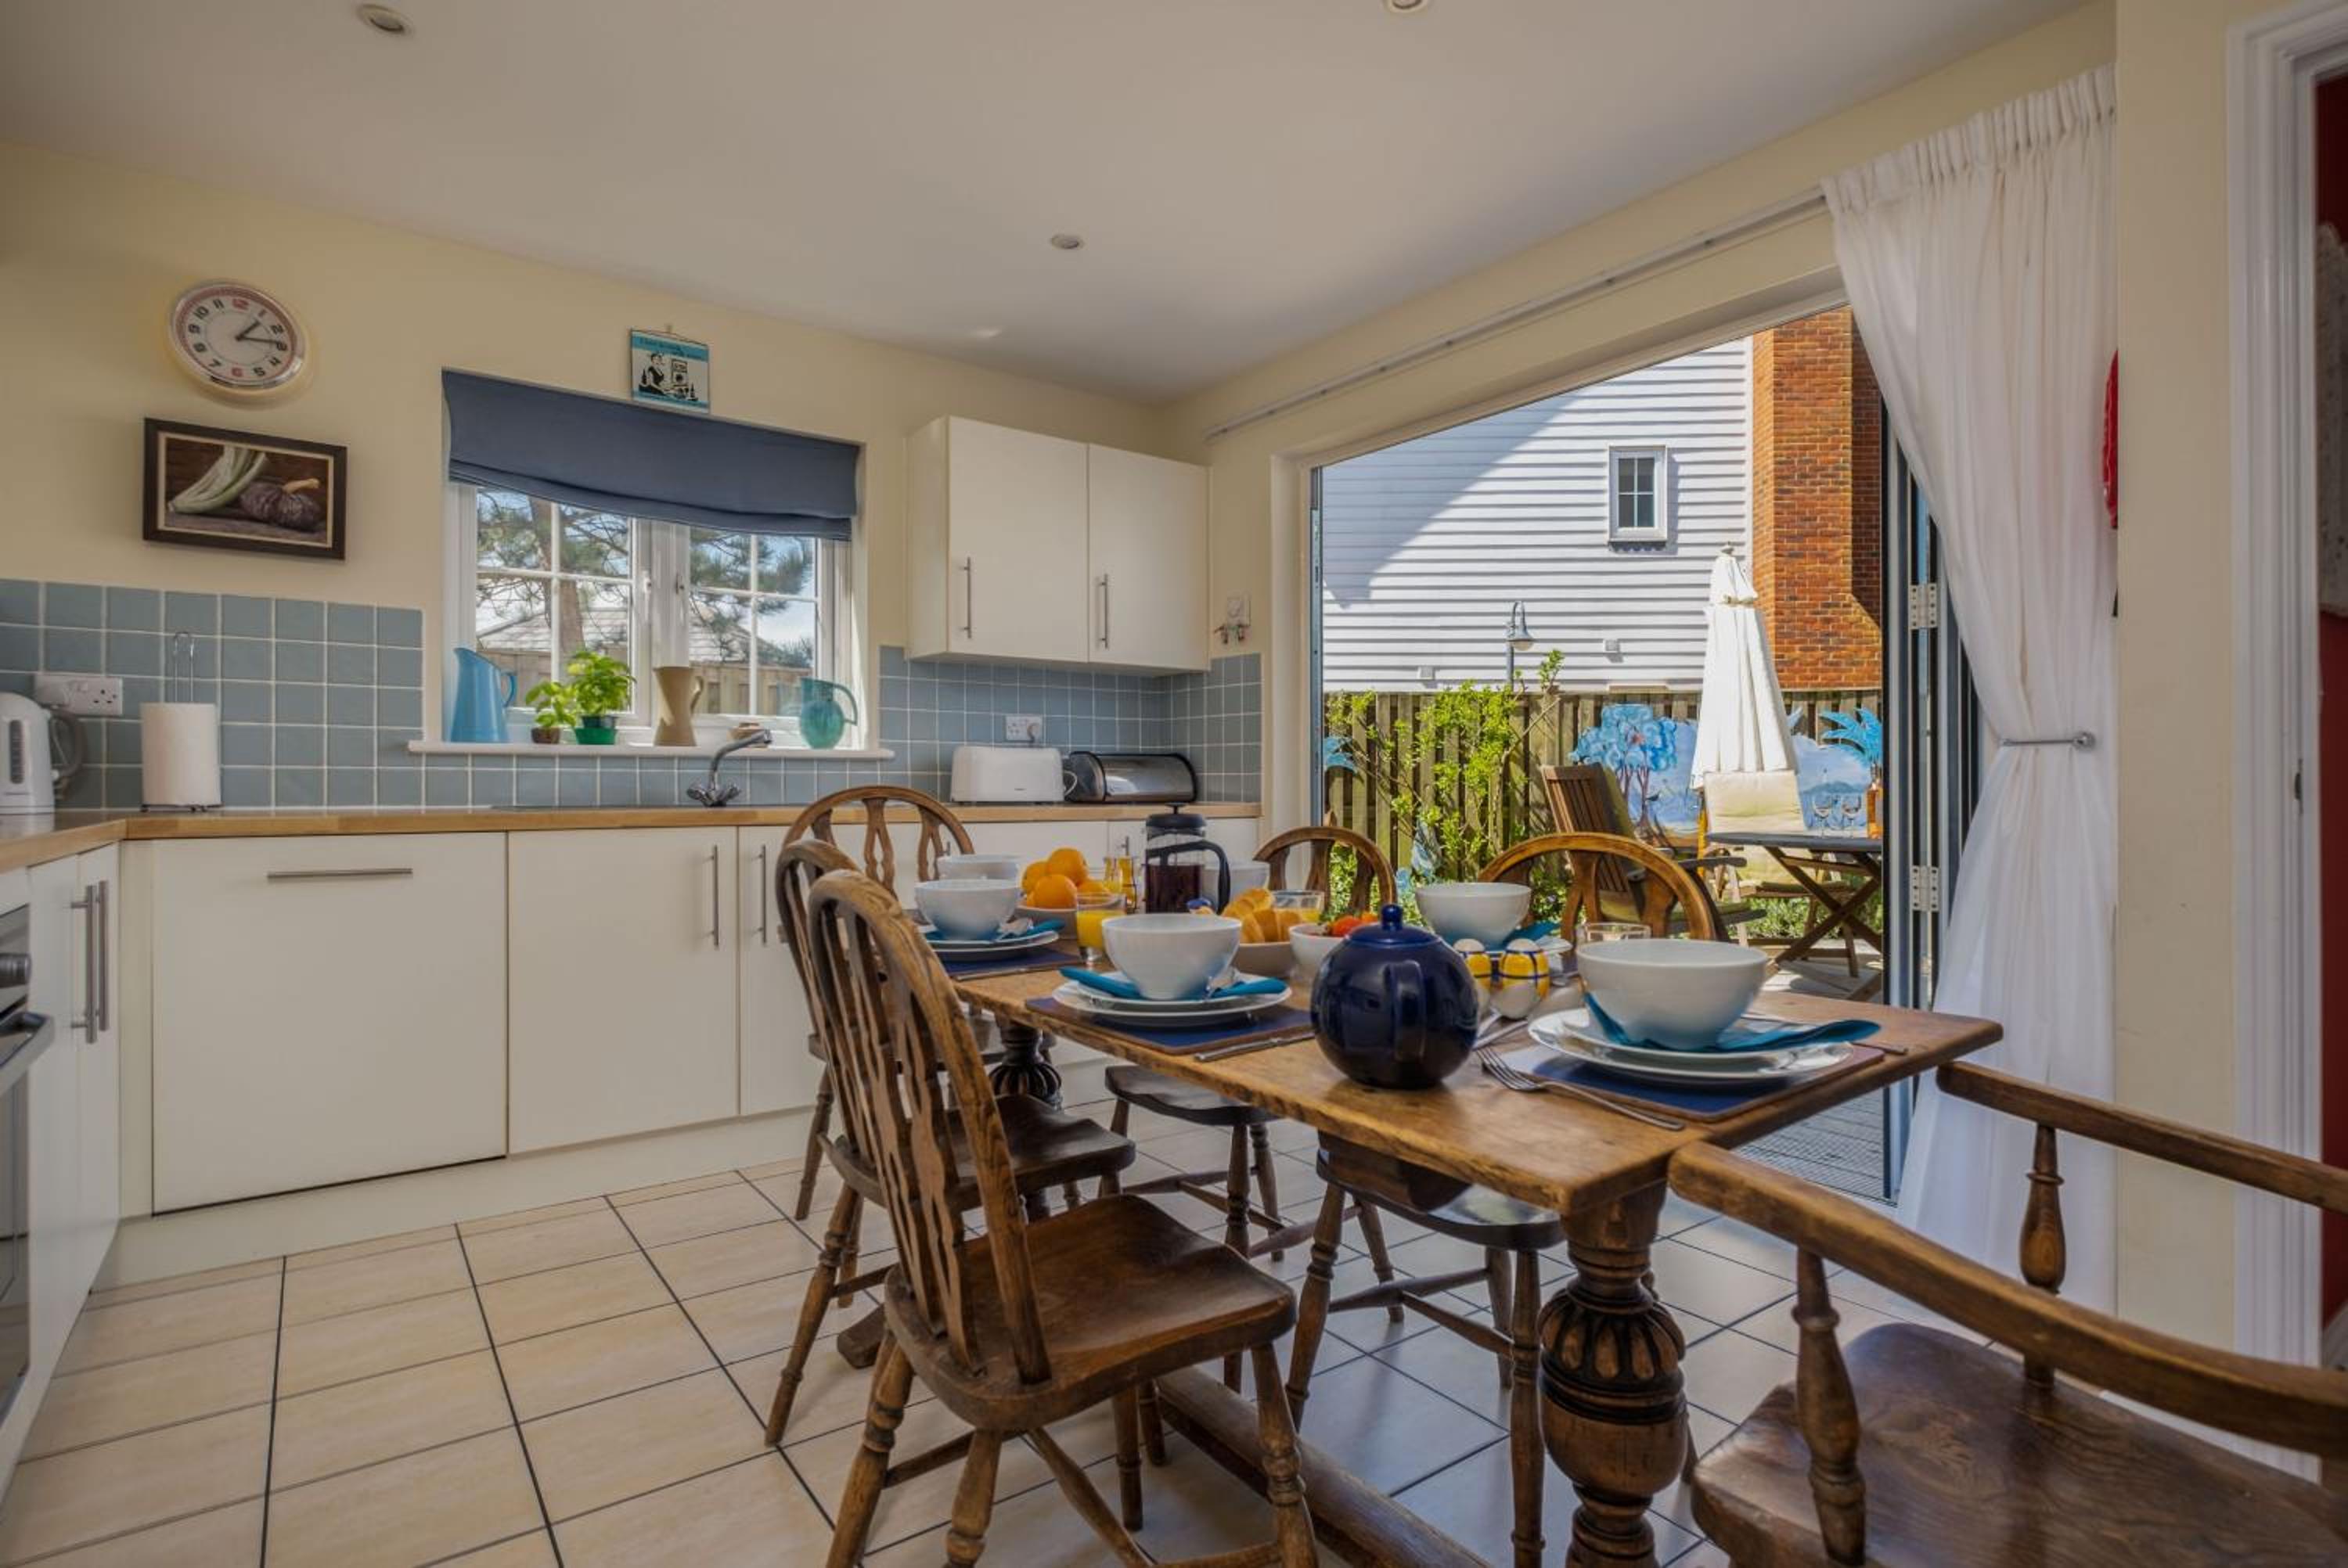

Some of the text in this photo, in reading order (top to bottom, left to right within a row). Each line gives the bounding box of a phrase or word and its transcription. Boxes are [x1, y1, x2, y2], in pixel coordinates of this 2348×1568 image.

[213, 299, 224, 308] 11
[193, 306, 209, 319] 10
[258, 309, 267, 318] 1
[188, 324, 200, 334] 9
[271, 324, 284, 335] 2
[209, 358, 221, 368] 7
[268, 356, 282, 365] 4
[231, 367, 243, 377] 6
[254, 367, 266, 376] 5
